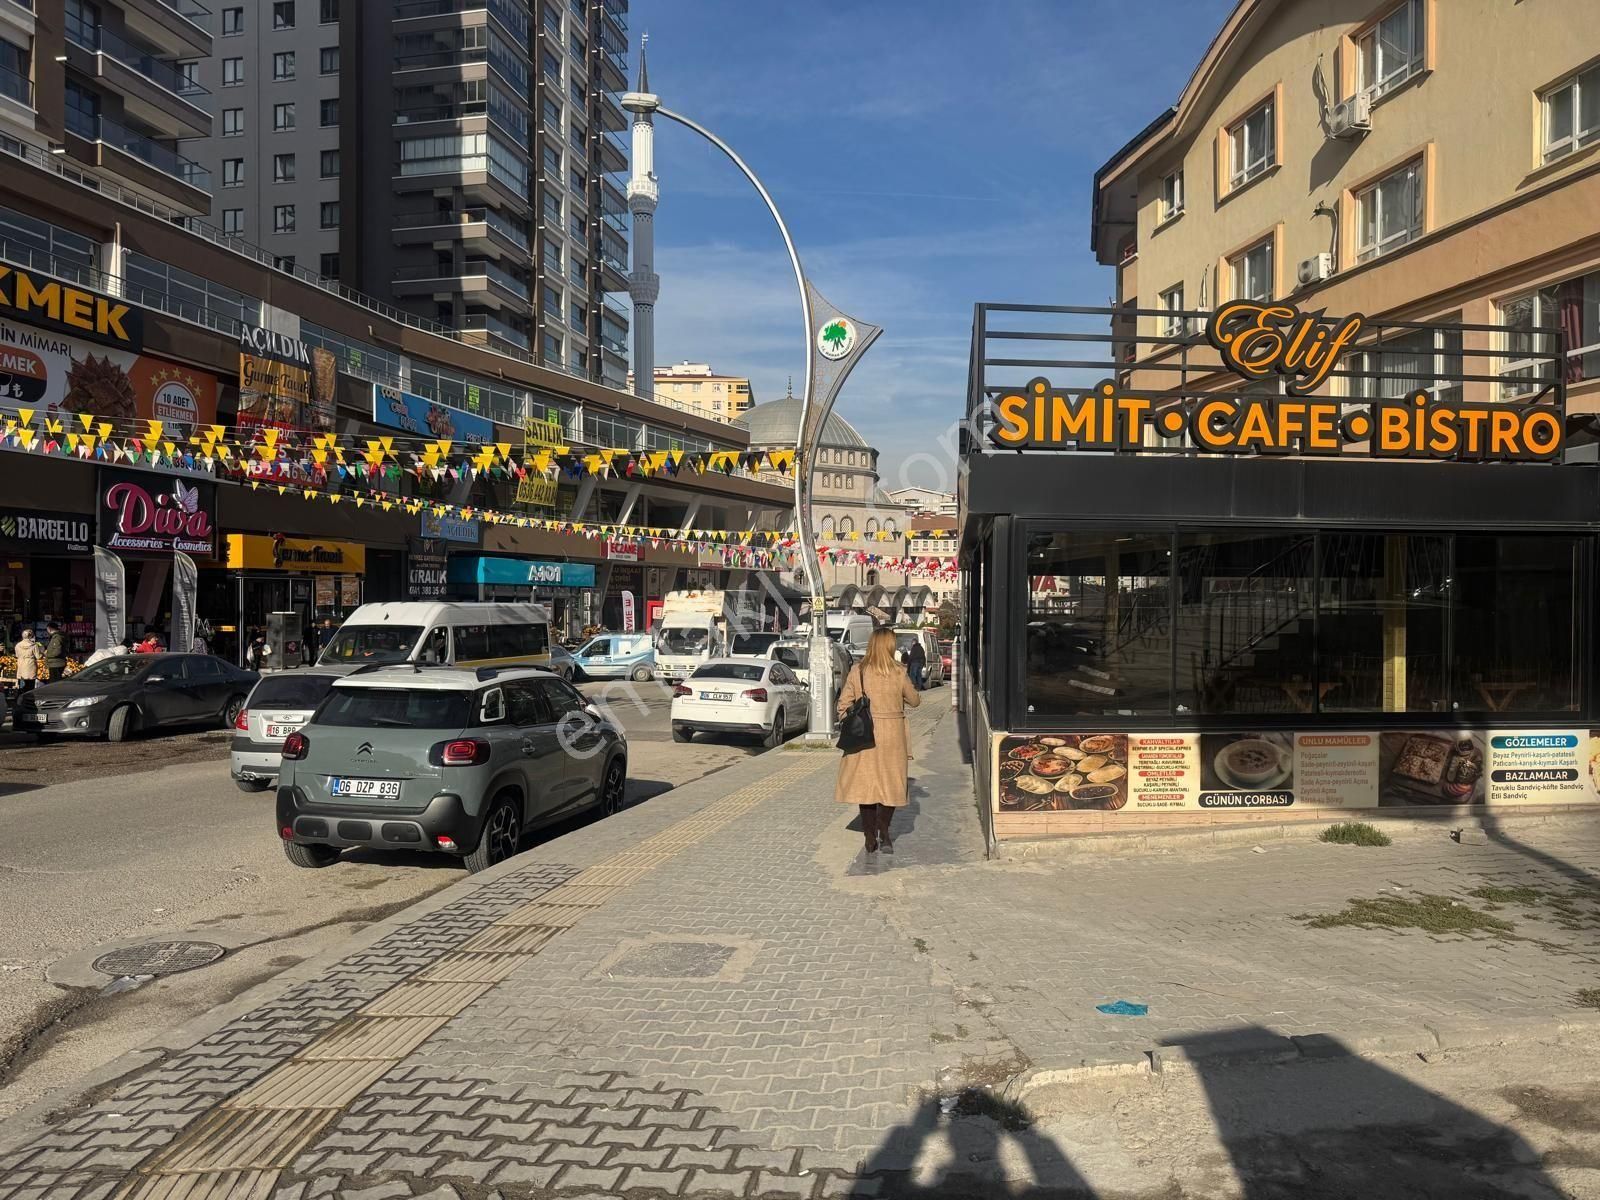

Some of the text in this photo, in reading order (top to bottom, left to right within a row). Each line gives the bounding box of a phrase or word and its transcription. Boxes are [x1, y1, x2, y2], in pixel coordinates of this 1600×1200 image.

[241, 323, 310, 365] AÇILDIK
[1215, 304, 1361, 390] Elif
[0, 352, 37, 375] MEK
[173, 395, 190, 408] ADET
[998, 382, 1562, 455] SİMİT CAFE BİSTRO
[525, 421, 563, 445] SATILIK
[106, 482, 212, 537] Diva
[17, 516, 89, 543] BARGELLO
[409, 569, 448, 584] KİRALIK
[1505, 736, 1567, 747] GÖZLEMELER
[1492, 751, 1510, 760] Beyaz
[1505, 771, 1568, 781] BAZLAMALAR
[339, 780, 398, 795] 06 DZP 836
[1491, 784, 1516, 792] Tavuklu
[1205, 793, 1242, 806] GÜNÜN
[1244, 794, 1288, 807] ÇORBASI
[1491, 792, 1528, 800] Etli Sandviç
